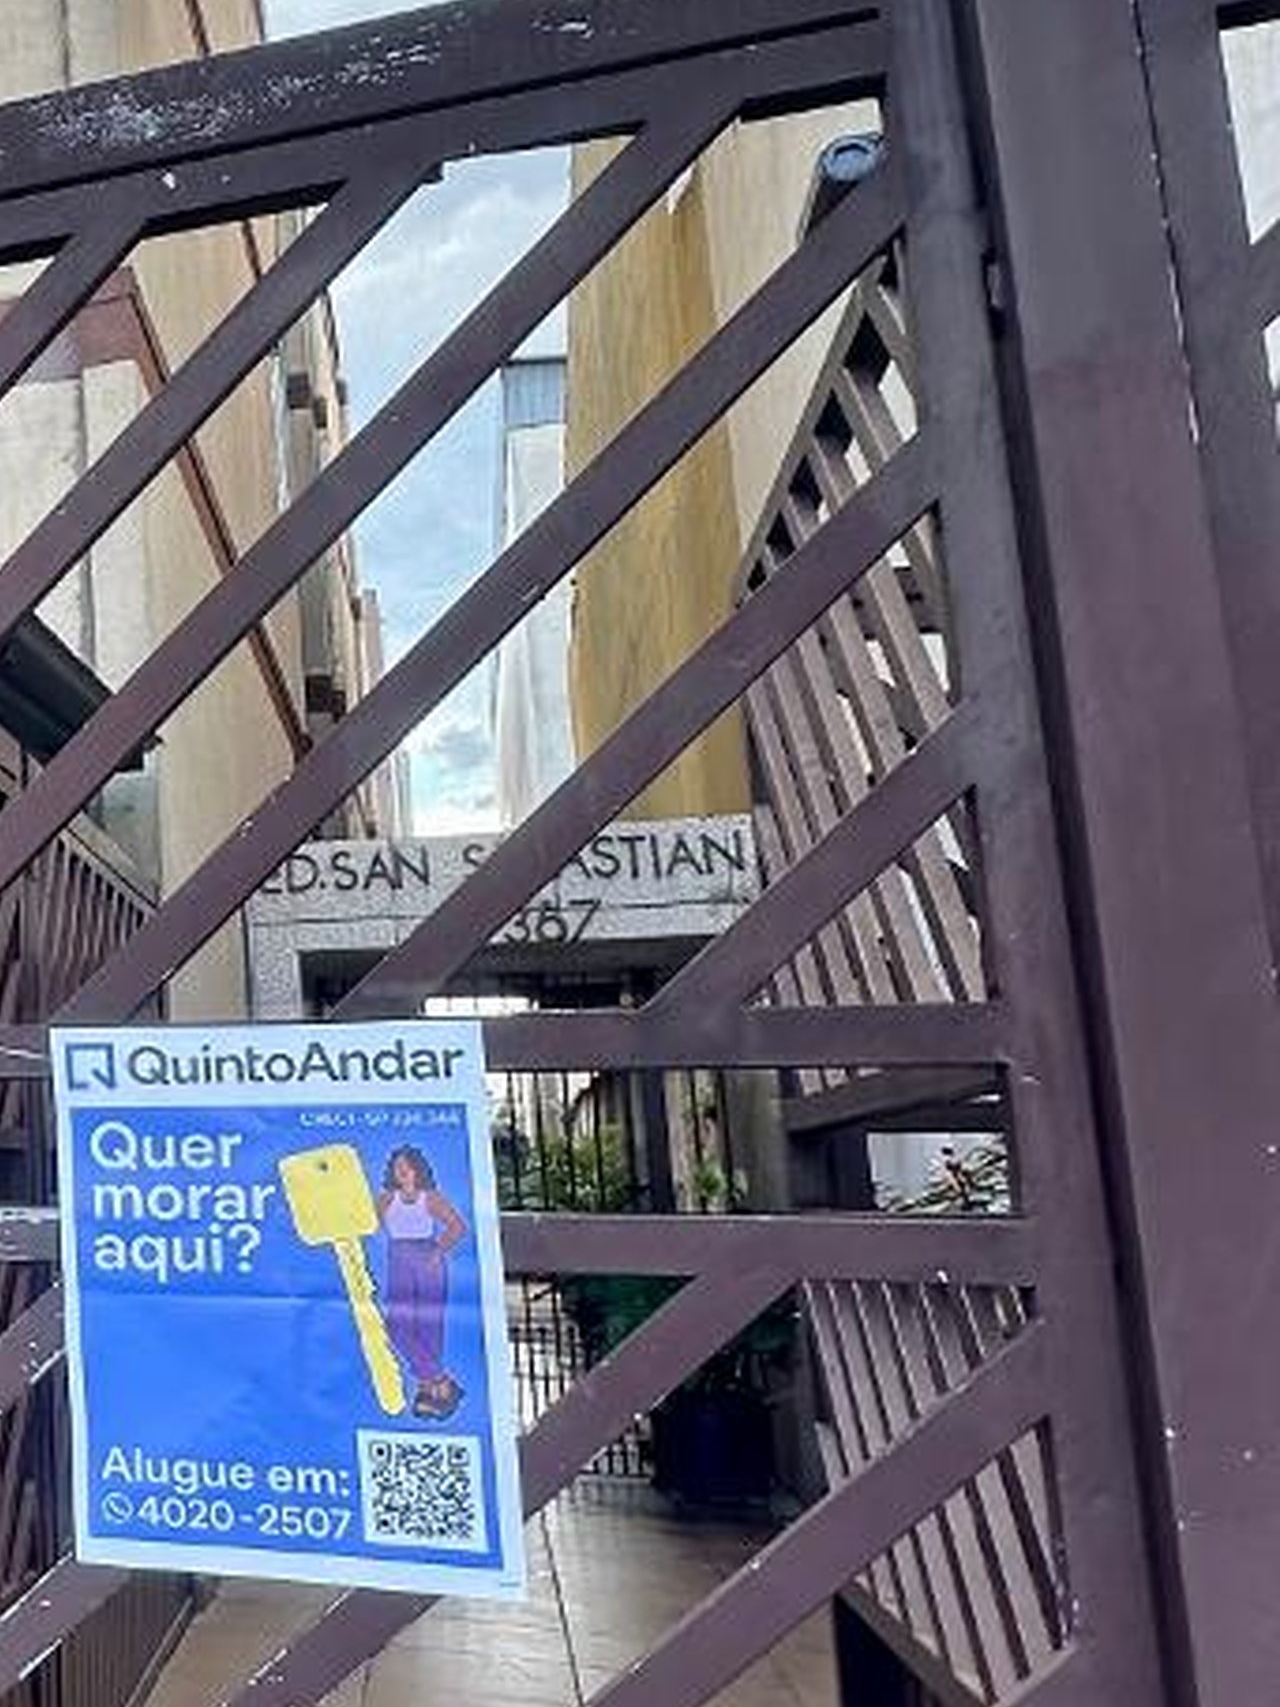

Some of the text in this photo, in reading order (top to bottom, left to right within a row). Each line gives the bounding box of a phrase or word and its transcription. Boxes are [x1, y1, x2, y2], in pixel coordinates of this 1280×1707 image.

[462, 828, 744, 882] SSTIAN
[127, 1038, 465, 1085] QuintoAndar
[90, 1120, 243, 1171] Quer
[93, 1183, 277, 1221] morar
[94, 1222, 262, 1284] aqui?
[101, 1446, 351, 1498] Alugue em:
[137, 1496, 353, 1541] 4020-2507
